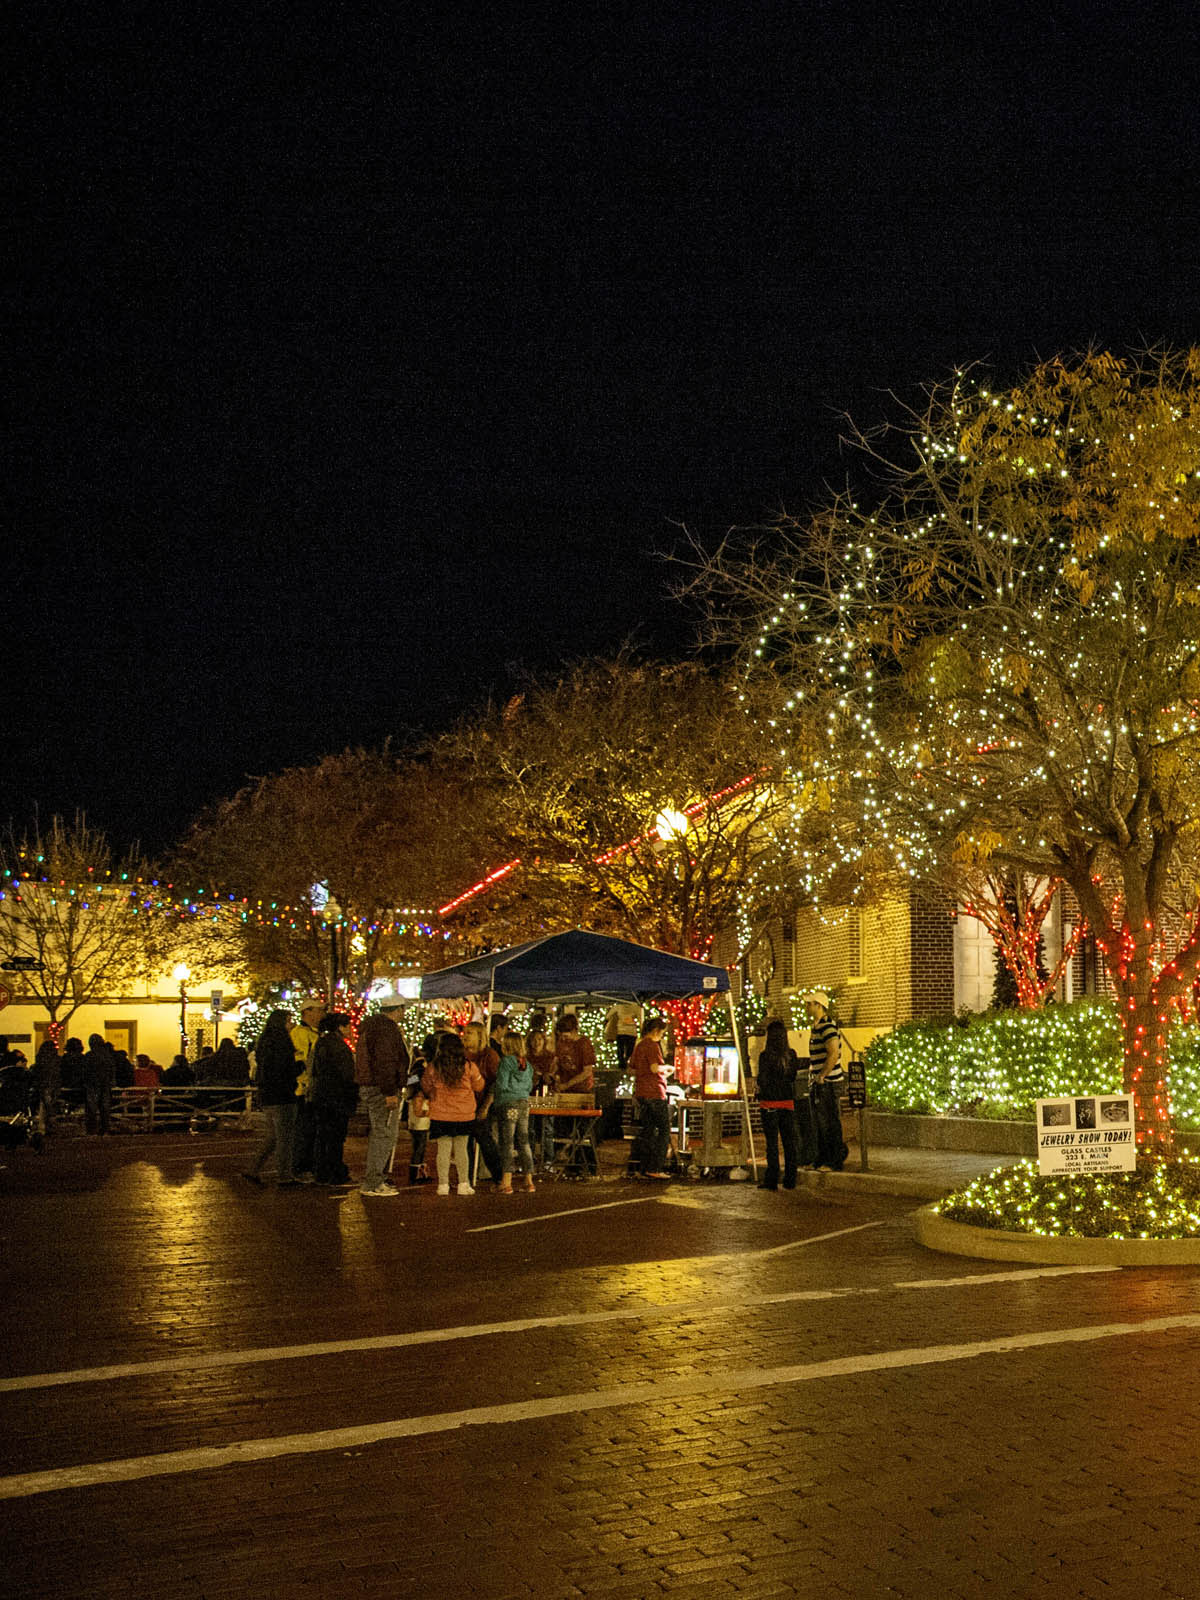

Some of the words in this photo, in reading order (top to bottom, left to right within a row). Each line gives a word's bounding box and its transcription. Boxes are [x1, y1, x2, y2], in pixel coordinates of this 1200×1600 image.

[1041, 1133, 1075, 1146] JEWELRY
[1078, 1132, 1101, 1144] SHOW
[1104, 1131, 1132, 1142] TODAY!
[1085, 1146, 1112, 1154] CASTLES
